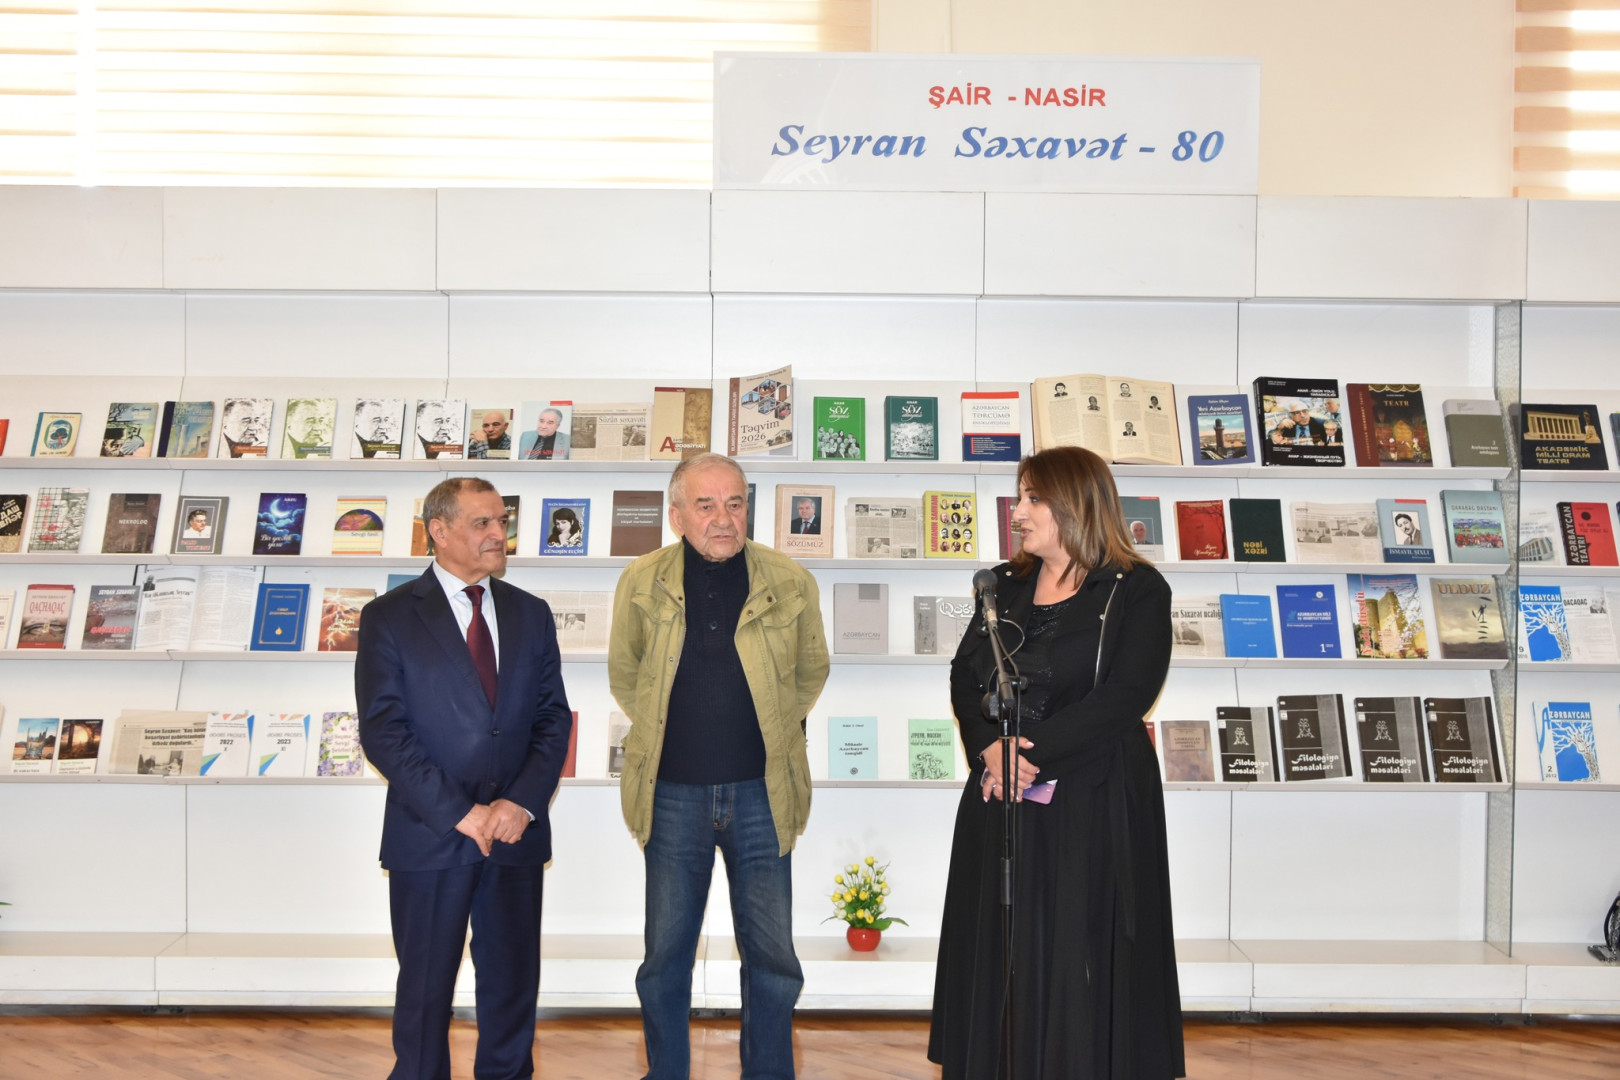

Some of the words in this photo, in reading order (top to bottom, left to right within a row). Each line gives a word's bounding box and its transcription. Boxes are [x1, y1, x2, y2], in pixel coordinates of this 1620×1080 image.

[928, 82, 992, 109] ŞAİR
[1024, 84, 1106, 108] NASİR
[771, 124, 927, 164] Seyran
[954, 126, 1128, 161] Səxavət
[1171, 129, 1225, 163] 80
[741, 420, 779, 434] Təqvim
[741, 433, 766, 443] 2026
[1564, 506, 1580, 563] AZƏRBAYCAN
[787, 540, 824, 548] SÖZÜMÜZ
[1578, 536, 1589, 564] TEATRI
[1437, 583, 1492, 595] ULDUZ
[1320, 644, 1326, 653] 1
